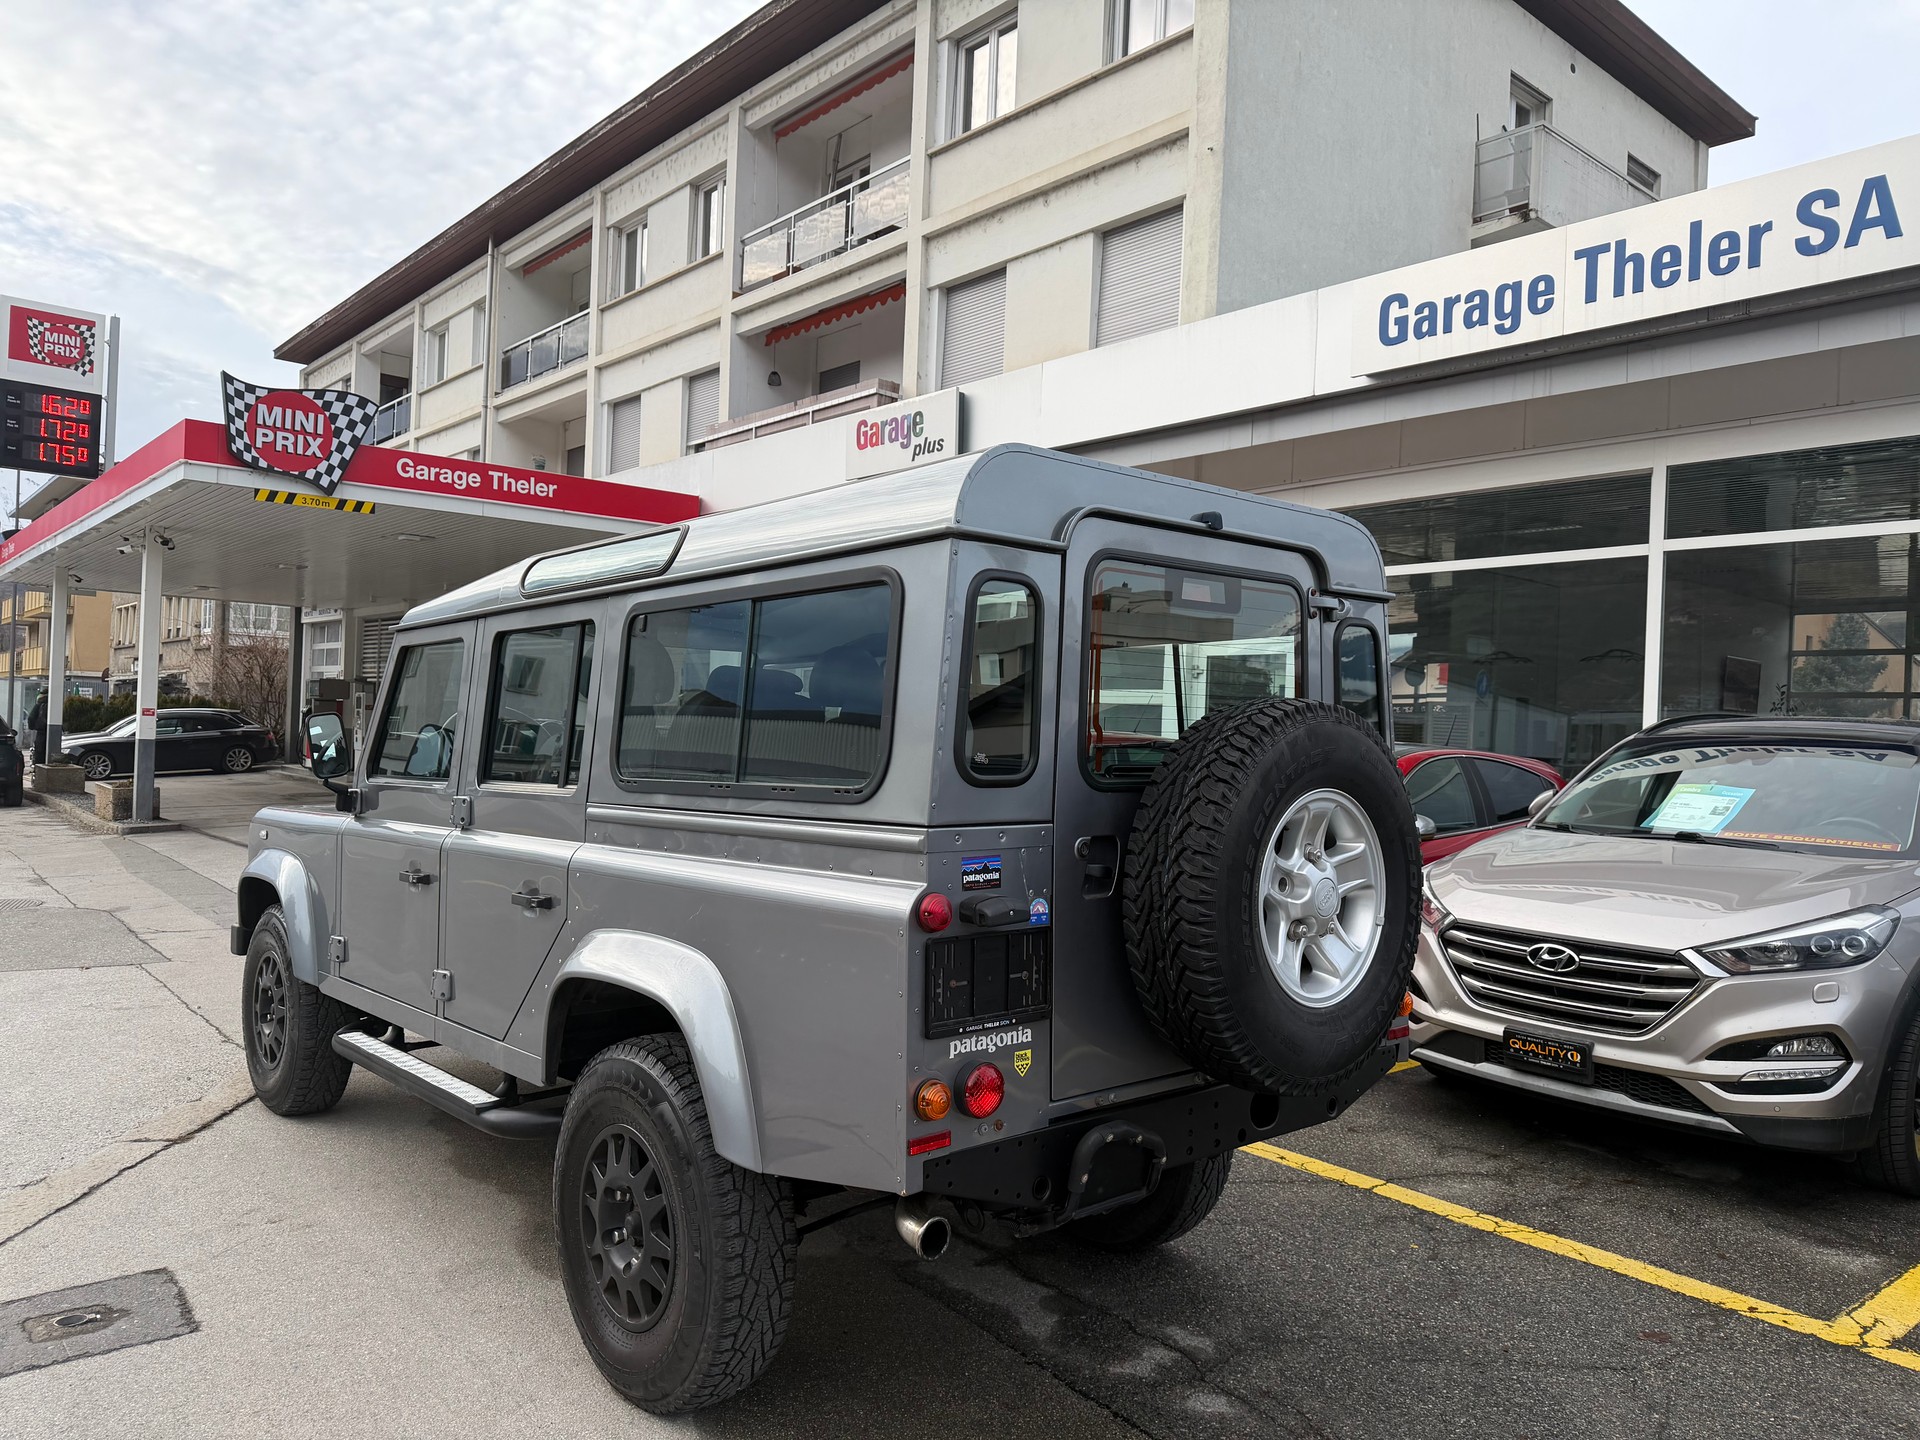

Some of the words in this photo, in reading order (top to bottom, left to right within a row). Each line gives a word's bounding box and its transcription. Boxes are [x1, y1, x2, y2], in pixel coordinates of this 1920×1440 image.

[1378, 273, 1556, 347] Garage
[1574, 218, 1773, 304] Theler
[1794, 173, 1904, 257] SA
[43, 342, 81, 359] PRIX
[44, 330, 81, 348] MINI
[256, 403, 325, 435] MINI
[856, 410, 925, 451] Garage
[254, 428, 324, 459] PRIX
[911, 436, 945, 461] plus
[396, 457, 481, 490] Garage
[488, 470, 558, 498] Theler
[963, 871, 1000, 884] patagonia
[949, 1026, 1032, 1059] patagonia
[1509, 1038, 1567, 1057] QUALITY
